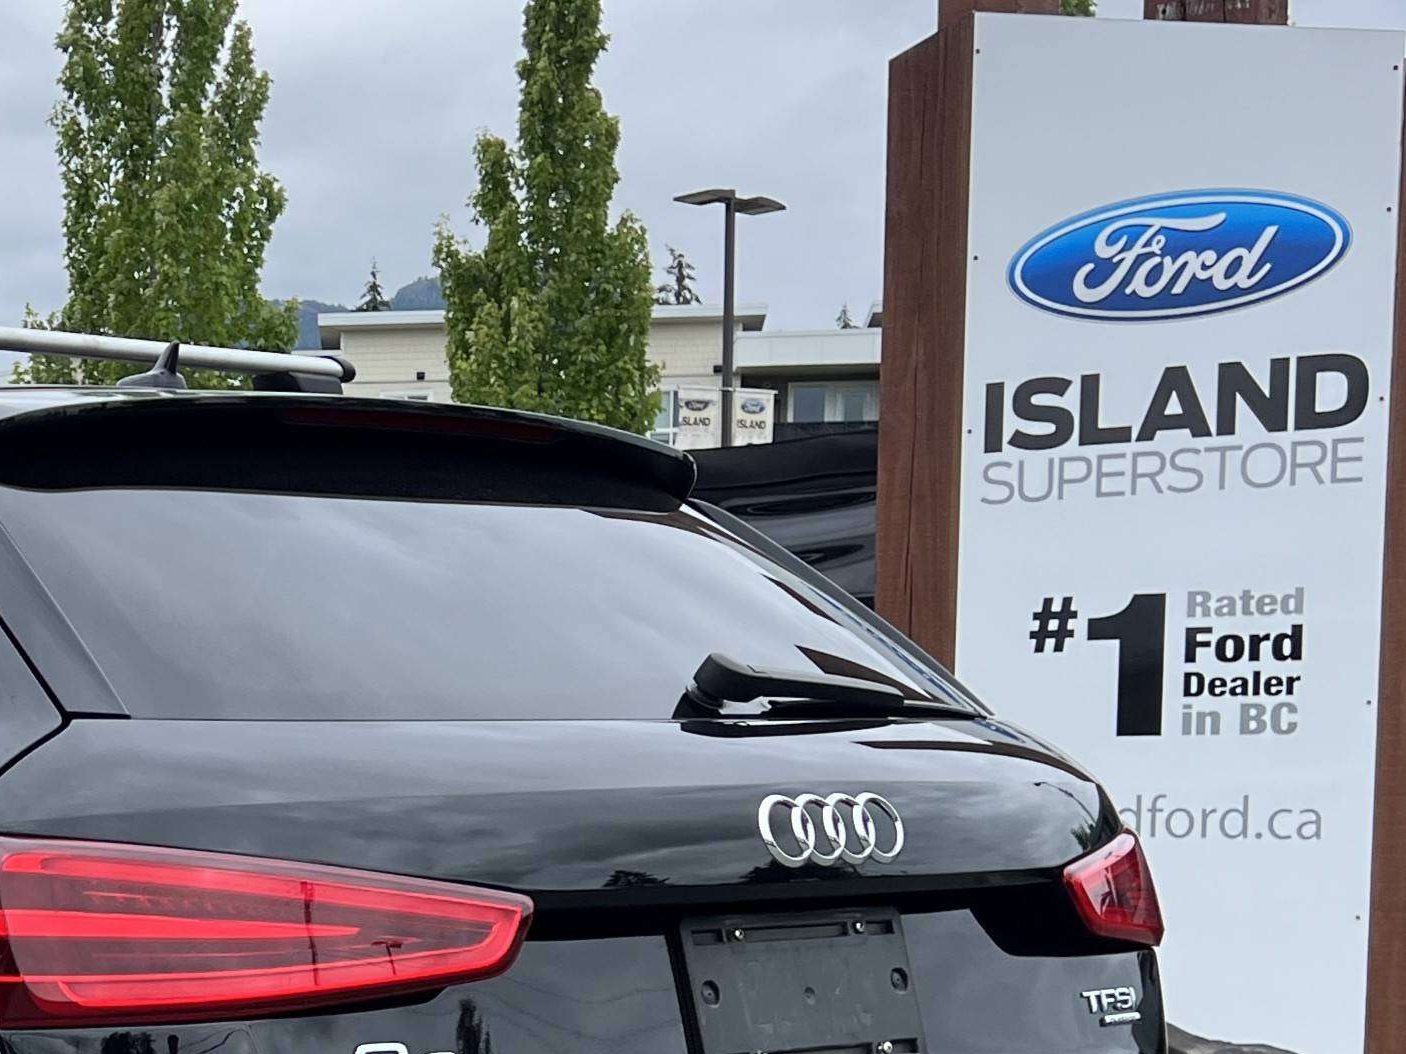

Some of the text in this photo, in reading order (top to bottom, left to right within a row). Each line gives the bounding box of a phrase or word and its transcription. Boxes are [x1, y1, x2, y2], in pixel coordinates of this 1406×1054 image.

[1073, 211, 1280, 303] Ford
[983, 353, 1370, 454] ISLAND
[980, 437, 1365, 506] SUPERSTORE
[1186, 587, 1305, 618] Rated
[1184, 623, 1304, 663] Ford
[1182, 671, 1301, 698] Dealer
[1181, 702, 1299, 736] in BC
[1080, 986, 1136, 1013] TFSI
